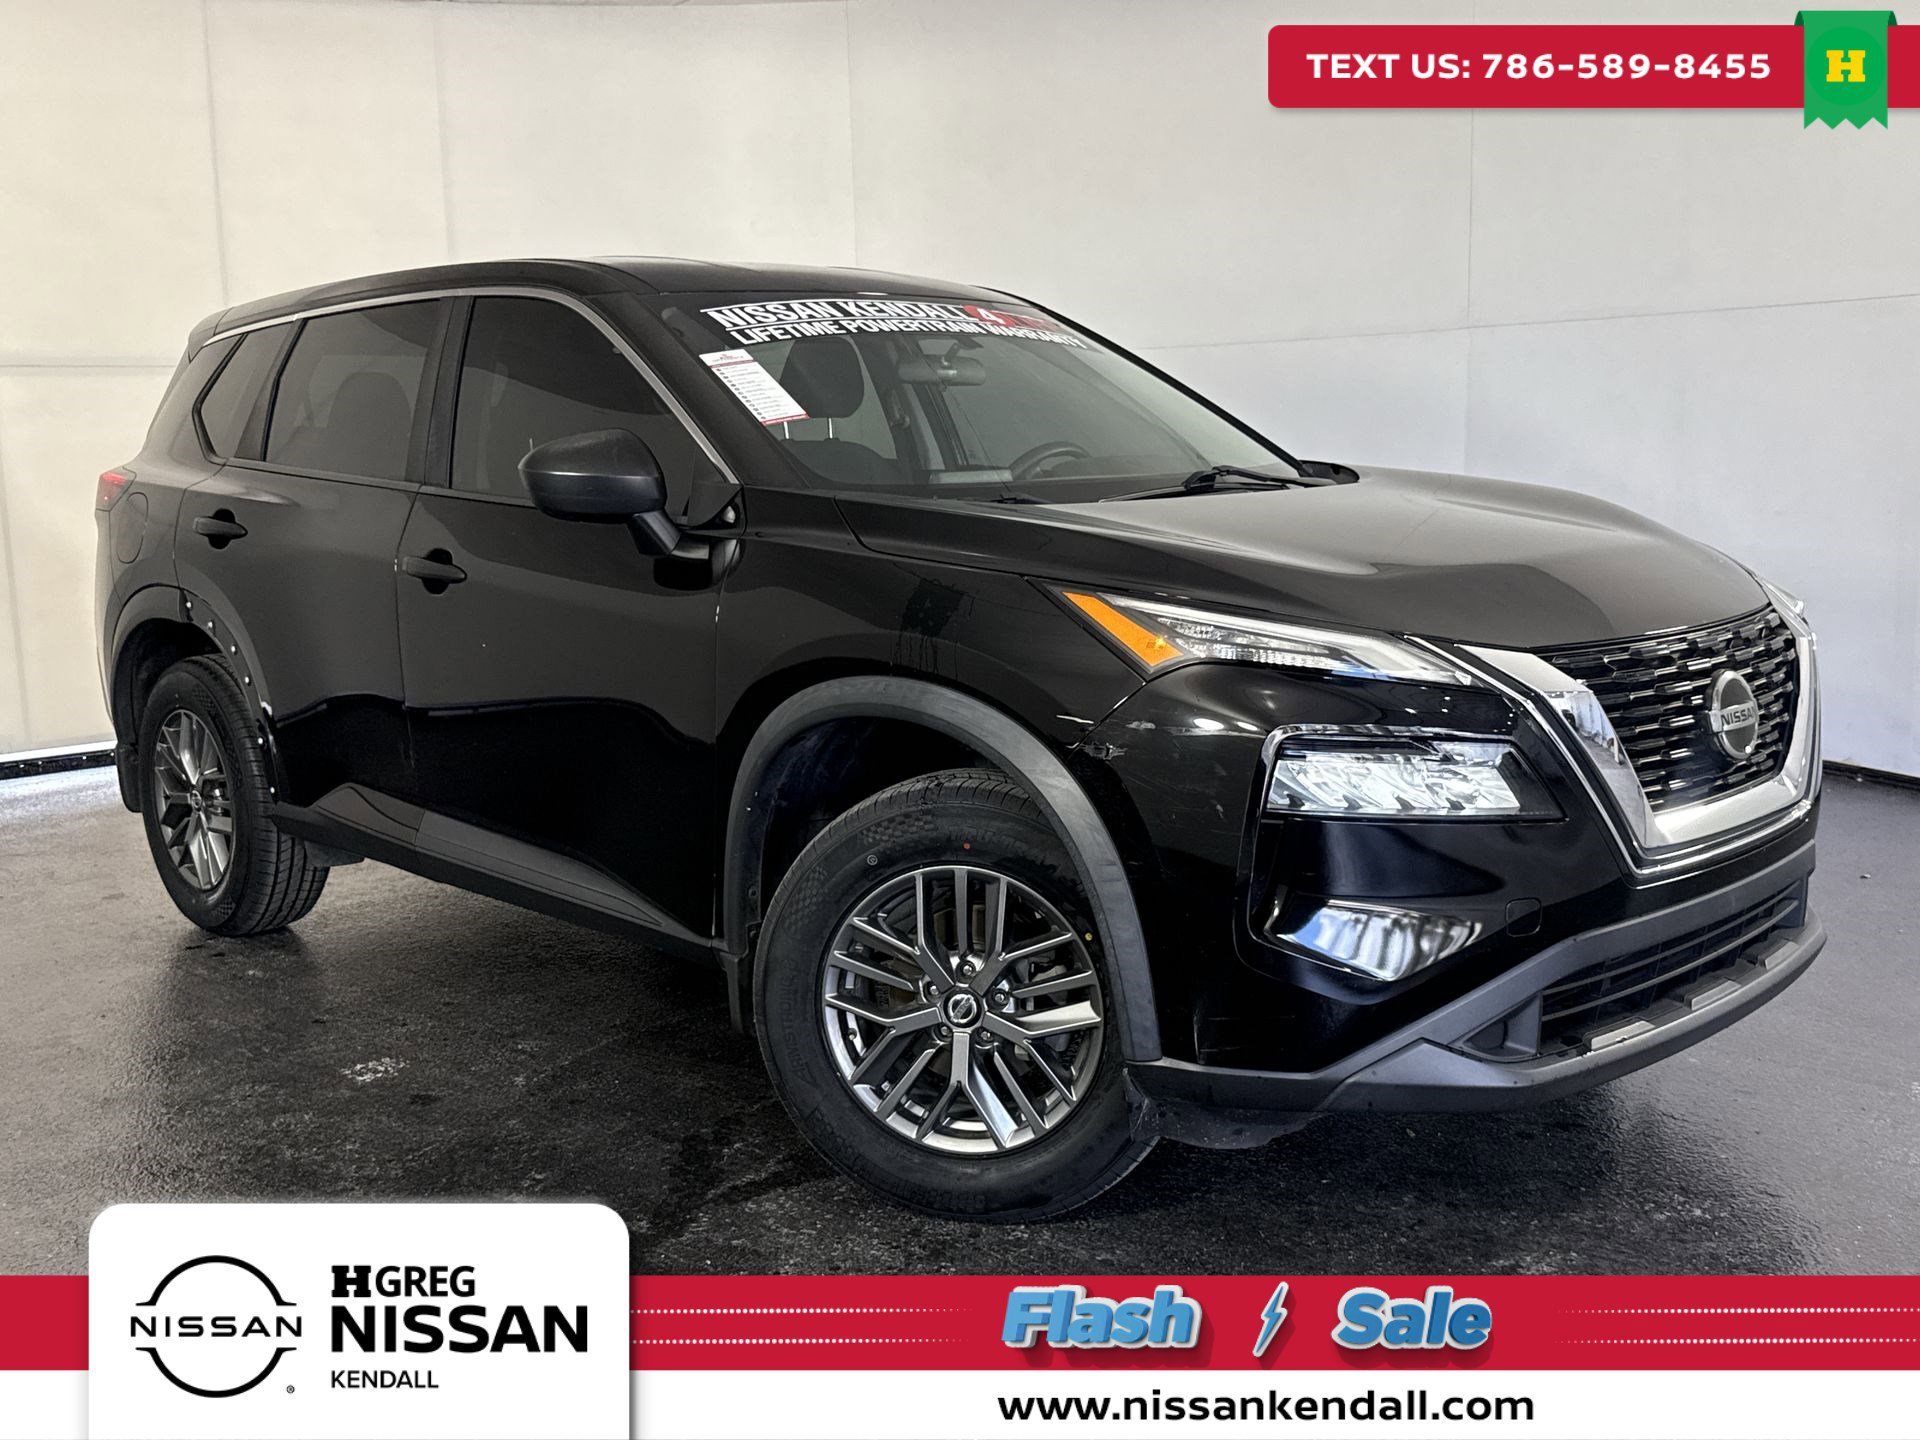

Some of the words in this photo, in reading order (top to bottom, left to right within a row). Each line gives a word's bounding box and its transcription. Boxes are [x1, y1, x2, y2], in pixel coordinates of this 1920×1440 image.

[707, 301, 844, 328] NISSAN
[837, 300, 979, 321] KENDALL
[729, 320, 848, 345] LIFETIME
[839, 318, 988, 334] POWERTRAIN
[978, 321, 1088, 349] WARRANTY
